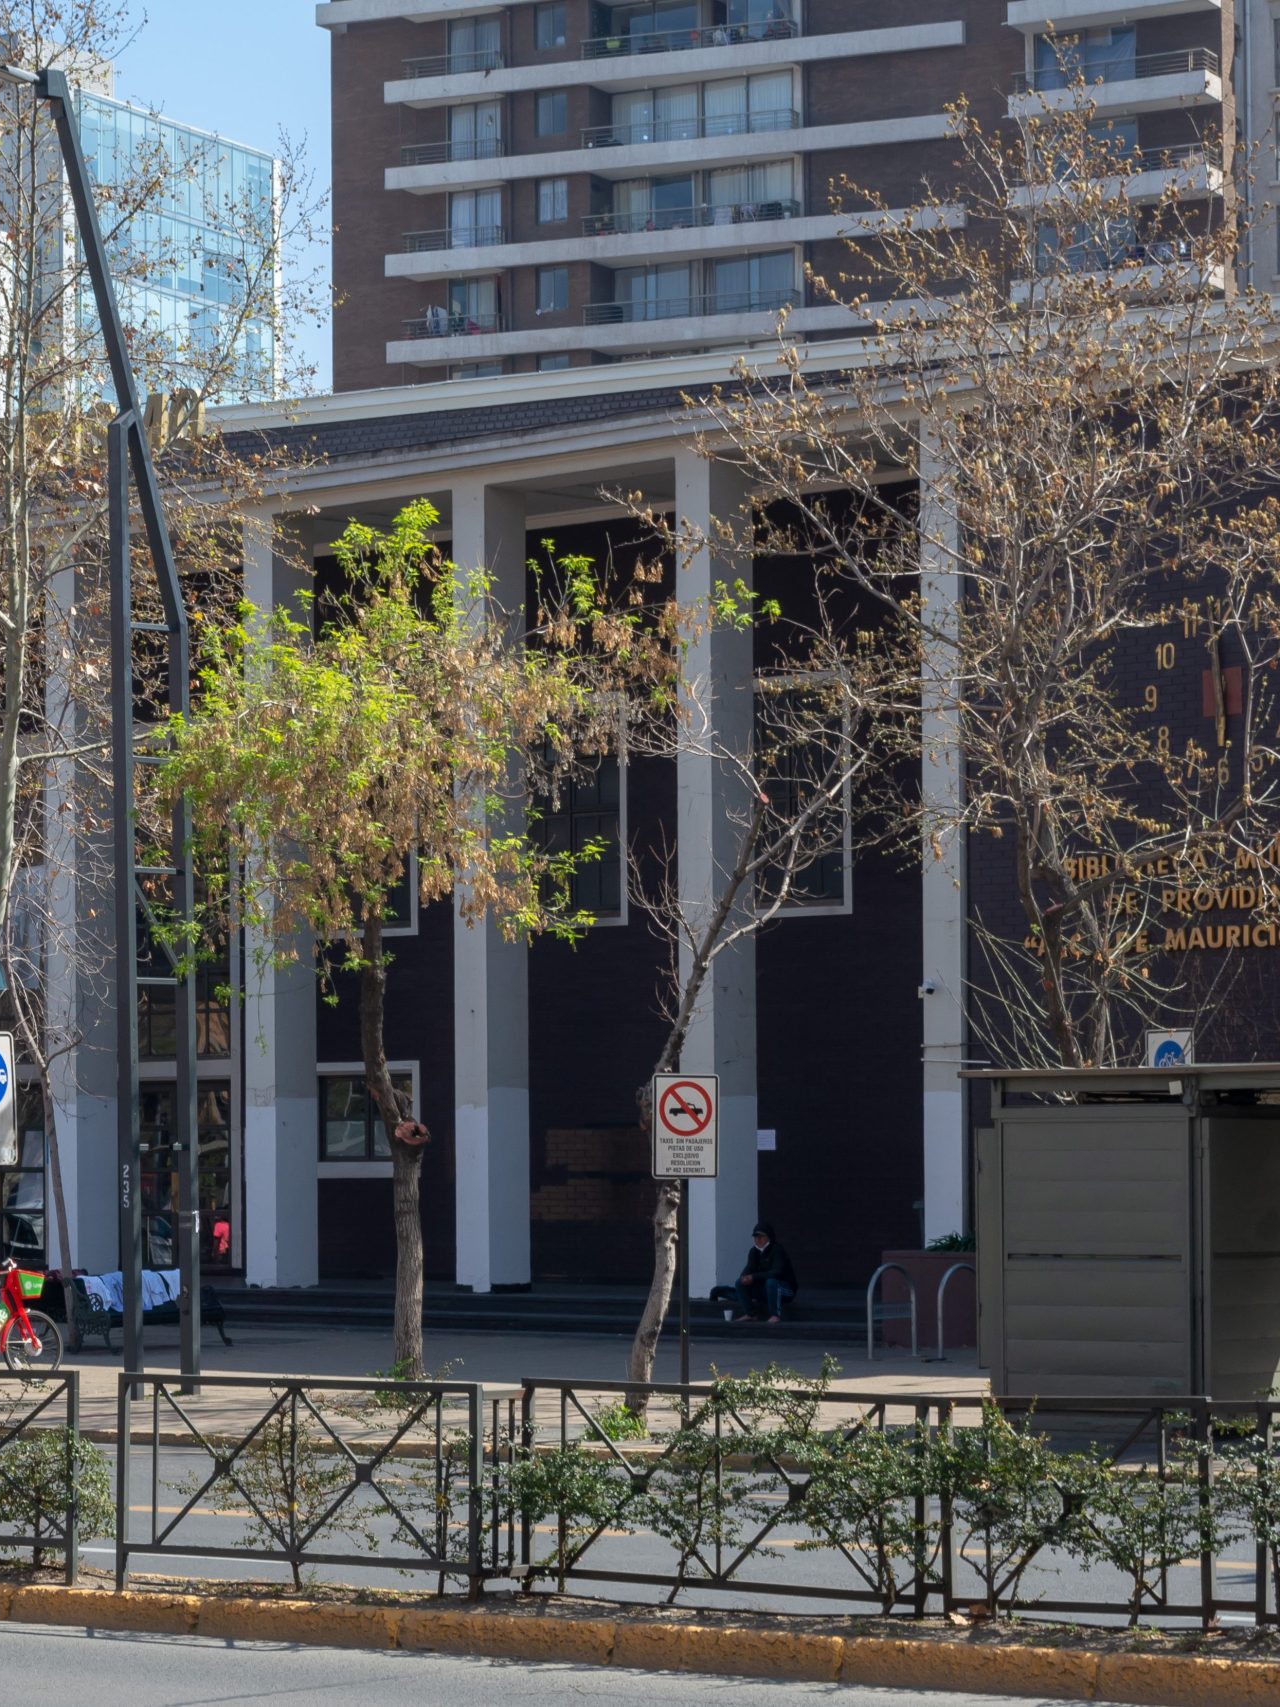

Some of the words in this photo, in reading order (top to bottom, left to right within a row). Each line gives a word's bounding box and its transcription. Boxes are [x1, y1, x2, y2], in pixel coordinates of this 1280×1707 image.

[1155, 642, 1176, 671] 10
[1145, 685, 1158, 712] 9
[1157, 725, 1170, 753] 8
[1217, 757, 1230, 784] 6
[1165, 922, 1280, 952] MAURICI
[122, 1164, 130, 1208] 235
